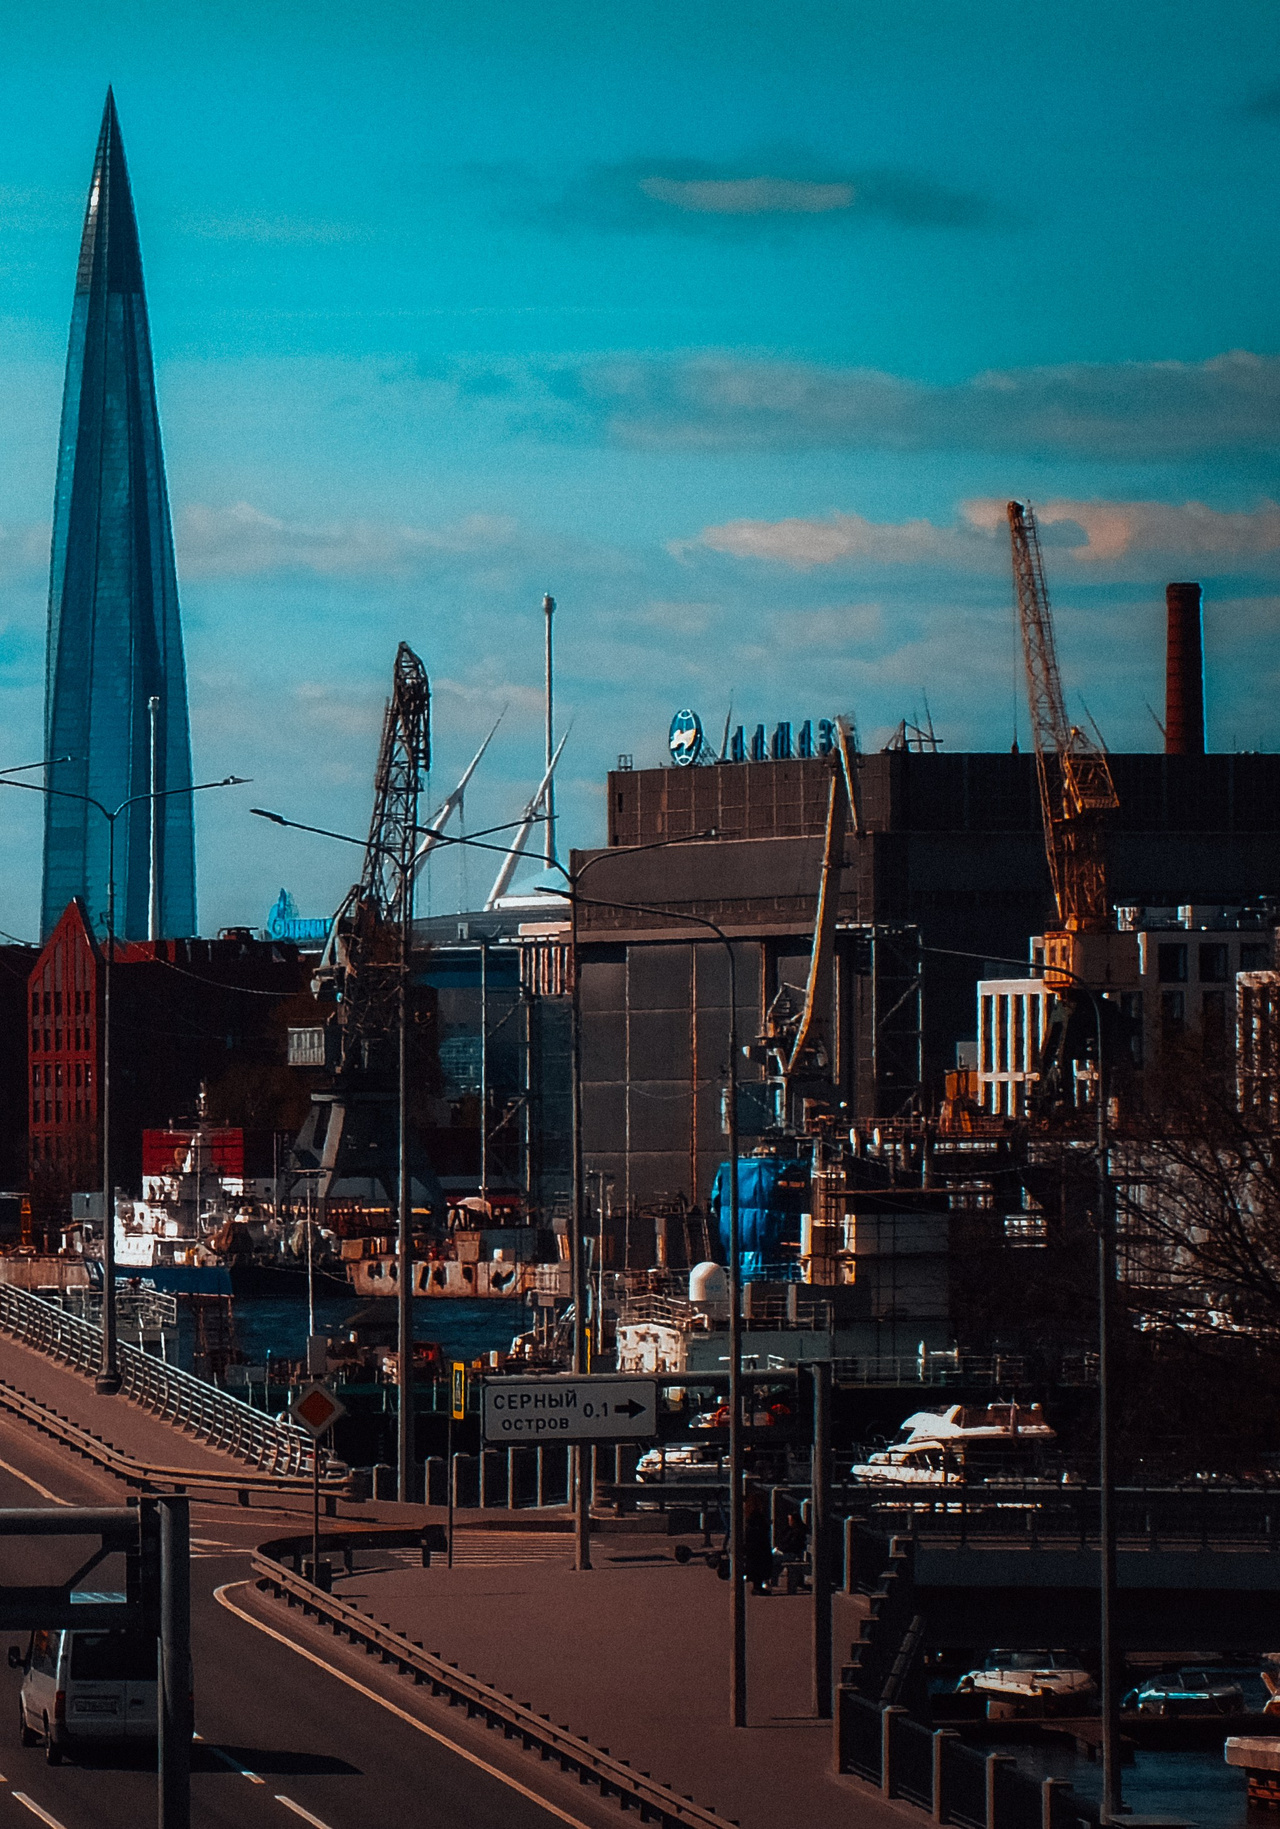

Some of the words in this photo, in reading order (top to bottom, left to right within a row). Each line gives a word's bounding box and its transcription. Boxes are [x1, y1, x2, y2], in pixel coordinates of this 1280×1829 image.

[493, 1389, 578, 1410] СЕРНЫЙ
[583, 1402, 608, 1418] 0.1
[501, 1417, 570, 1434] остров
